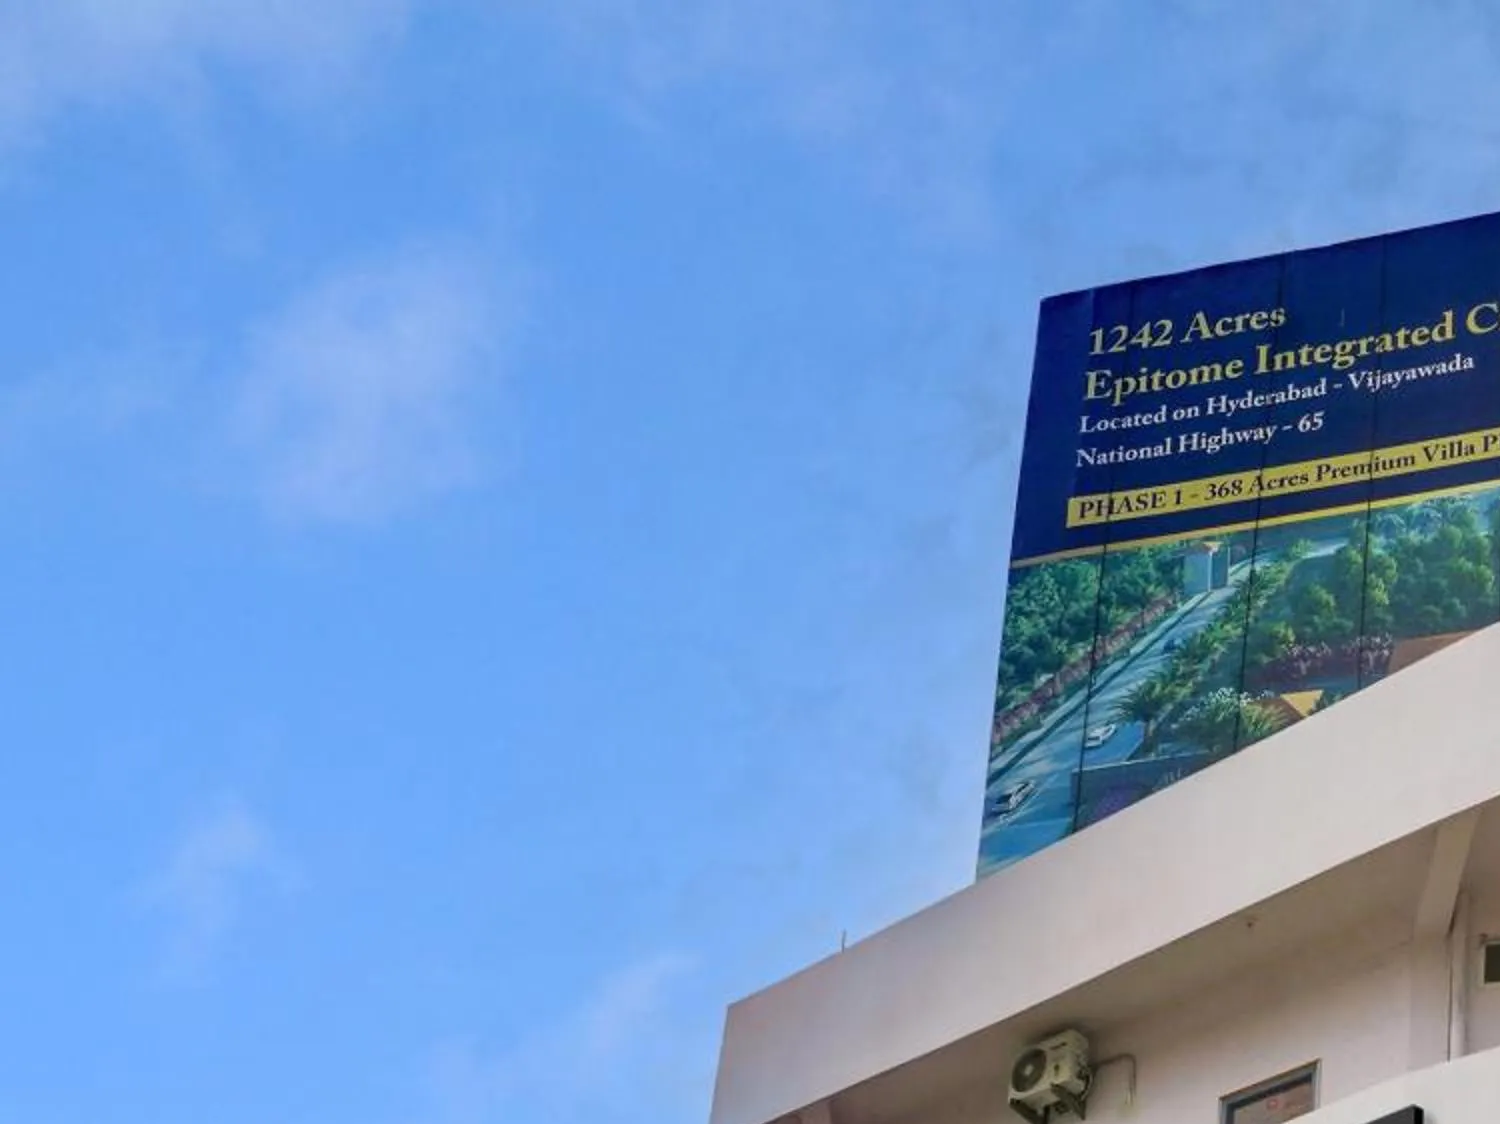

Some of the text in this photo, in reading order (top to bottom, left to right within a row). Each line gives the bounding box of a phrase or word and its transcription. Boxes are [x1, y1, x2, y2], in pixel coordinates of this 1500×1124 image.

[1084, 353, 1244, 406] Epitome
[1254, 309, 1457, 376] Integrated
[1089, 306, 1286, 356] 1242 Acres
[1079, 409, 1167, 434] Located
[1172, 403, 1200, 422] on
[1206, 378, 1327, 418] Hyderabad
[1347, 353, 1475, 394] Vijayawada
[1076, 433, 1172, 467] National
[1178, 423, 1278, 455] Highway
[1298, 411, 1325, 433] 65
[1077, 490, 1167, 521] PHASE
[1204, 479, 1243, 502] 368
[1248, 469, 1310, 495] Acres
[1314, 450, 1417, 484] Premium
[1421, 433, 1475, 463] Villa
